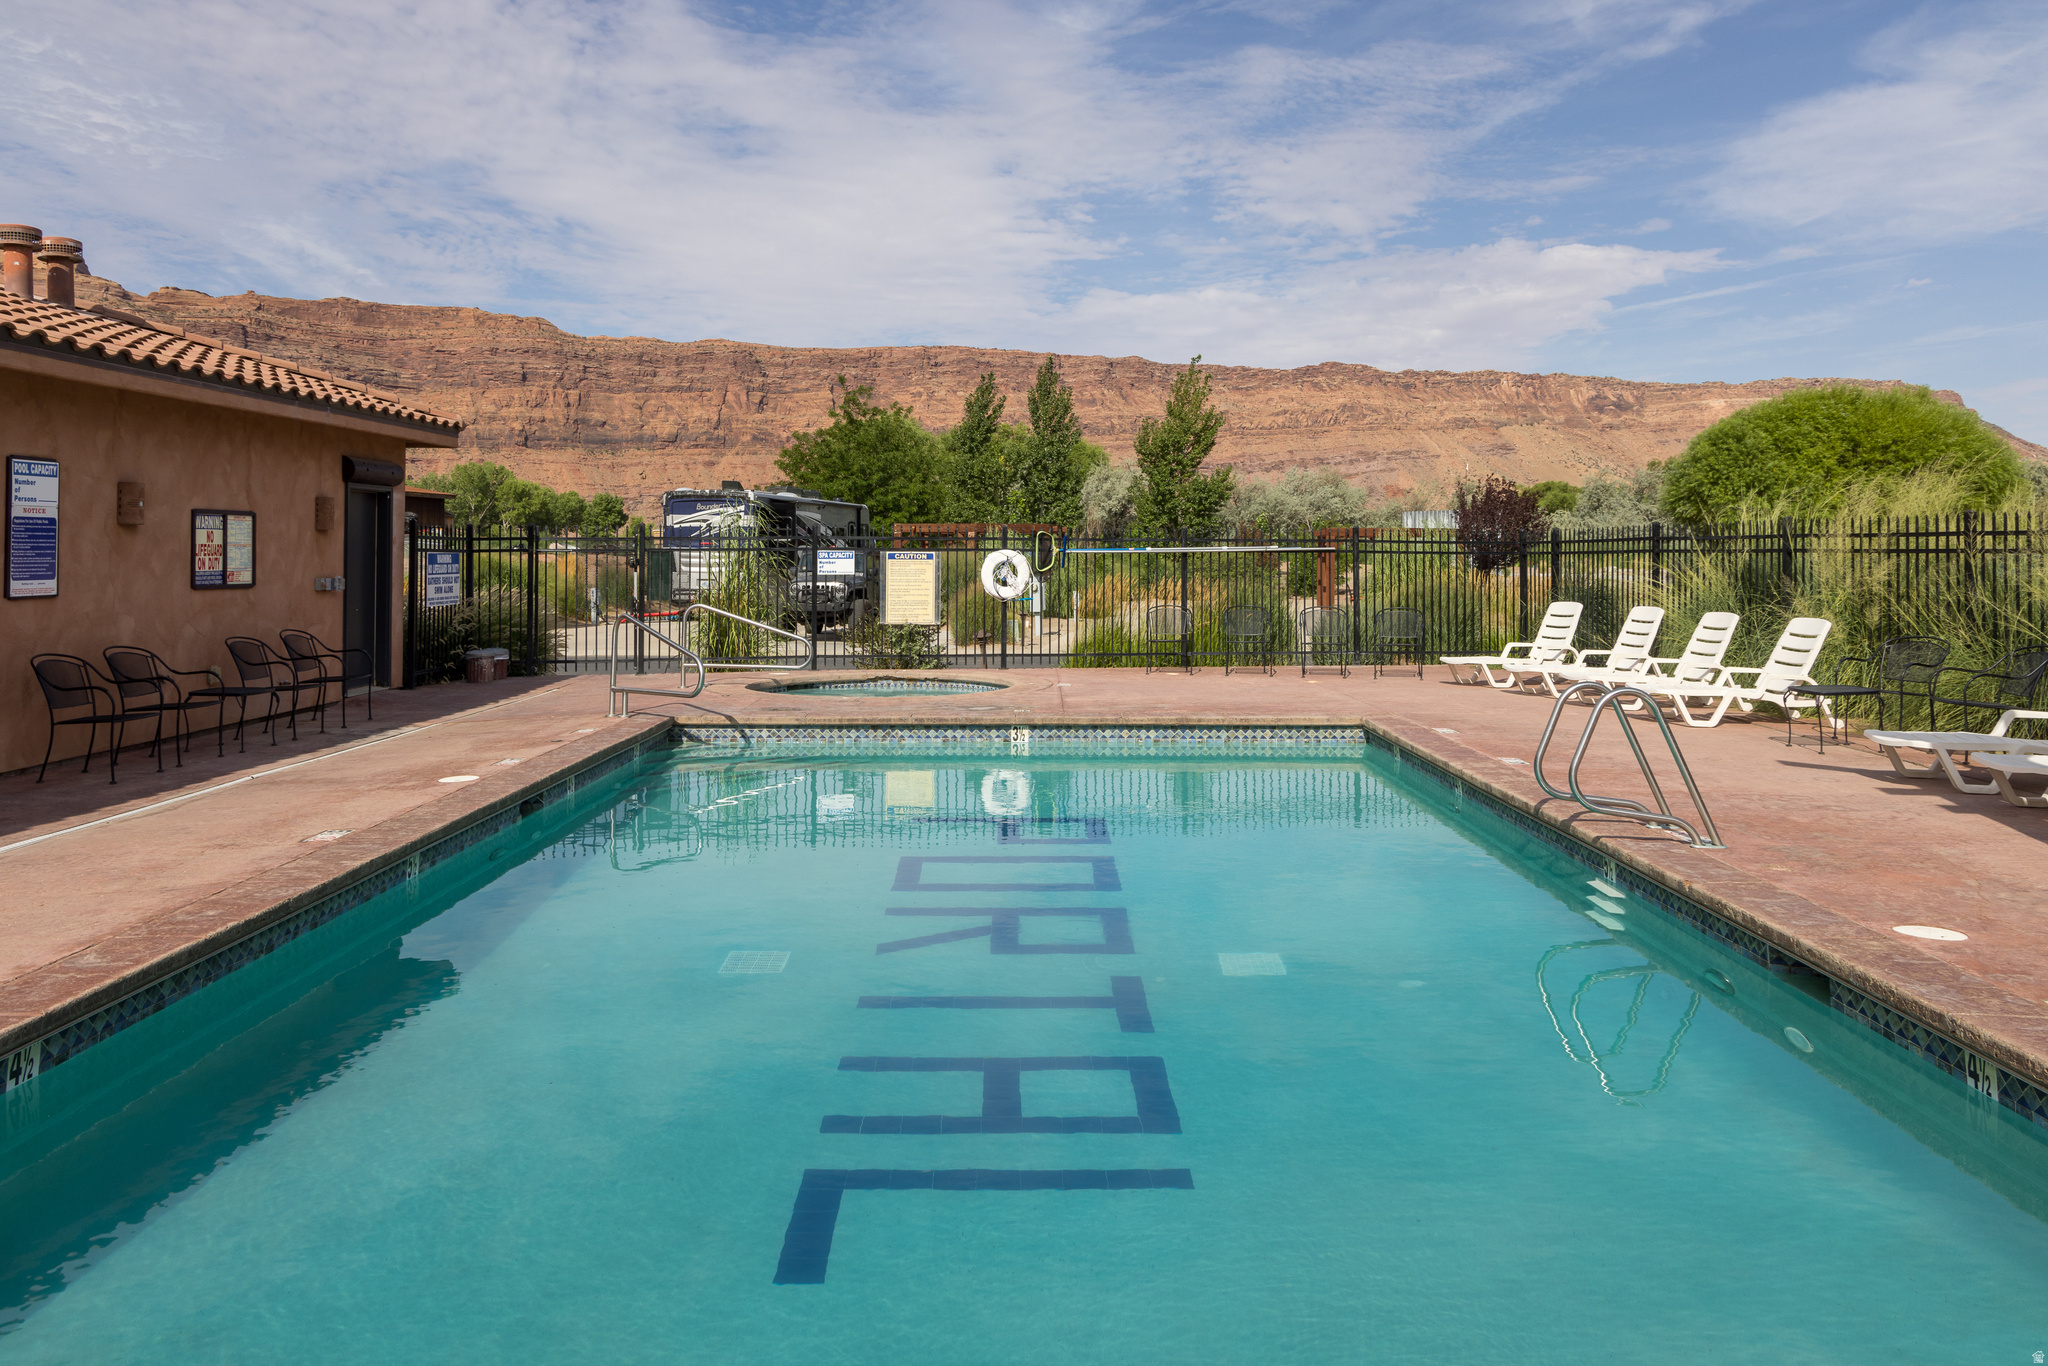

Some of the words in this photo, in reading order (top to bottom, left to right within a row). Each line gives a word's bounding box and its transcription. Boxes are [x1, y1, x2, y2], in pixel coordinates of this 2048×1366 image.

[14, 462, 29, 474] POOL
[30, 463, 57, 476] CAPACITY
[14, 478, 36, 486] Number
[696, 502, 722, 511] Bounder
[196, 515, 223, 529] WARNING
[206, 530, 214, 543] NO
[195, 544, 222, 556] LIFEGUARD
[818, 551, 828, 559] SPA
[829, 551, 853, 559] CAPACITY
[197, 557, 206, 570] ON
[208, 557, 220, 570] DUTY
[772, 816, 1195, 1285] PORTAL
